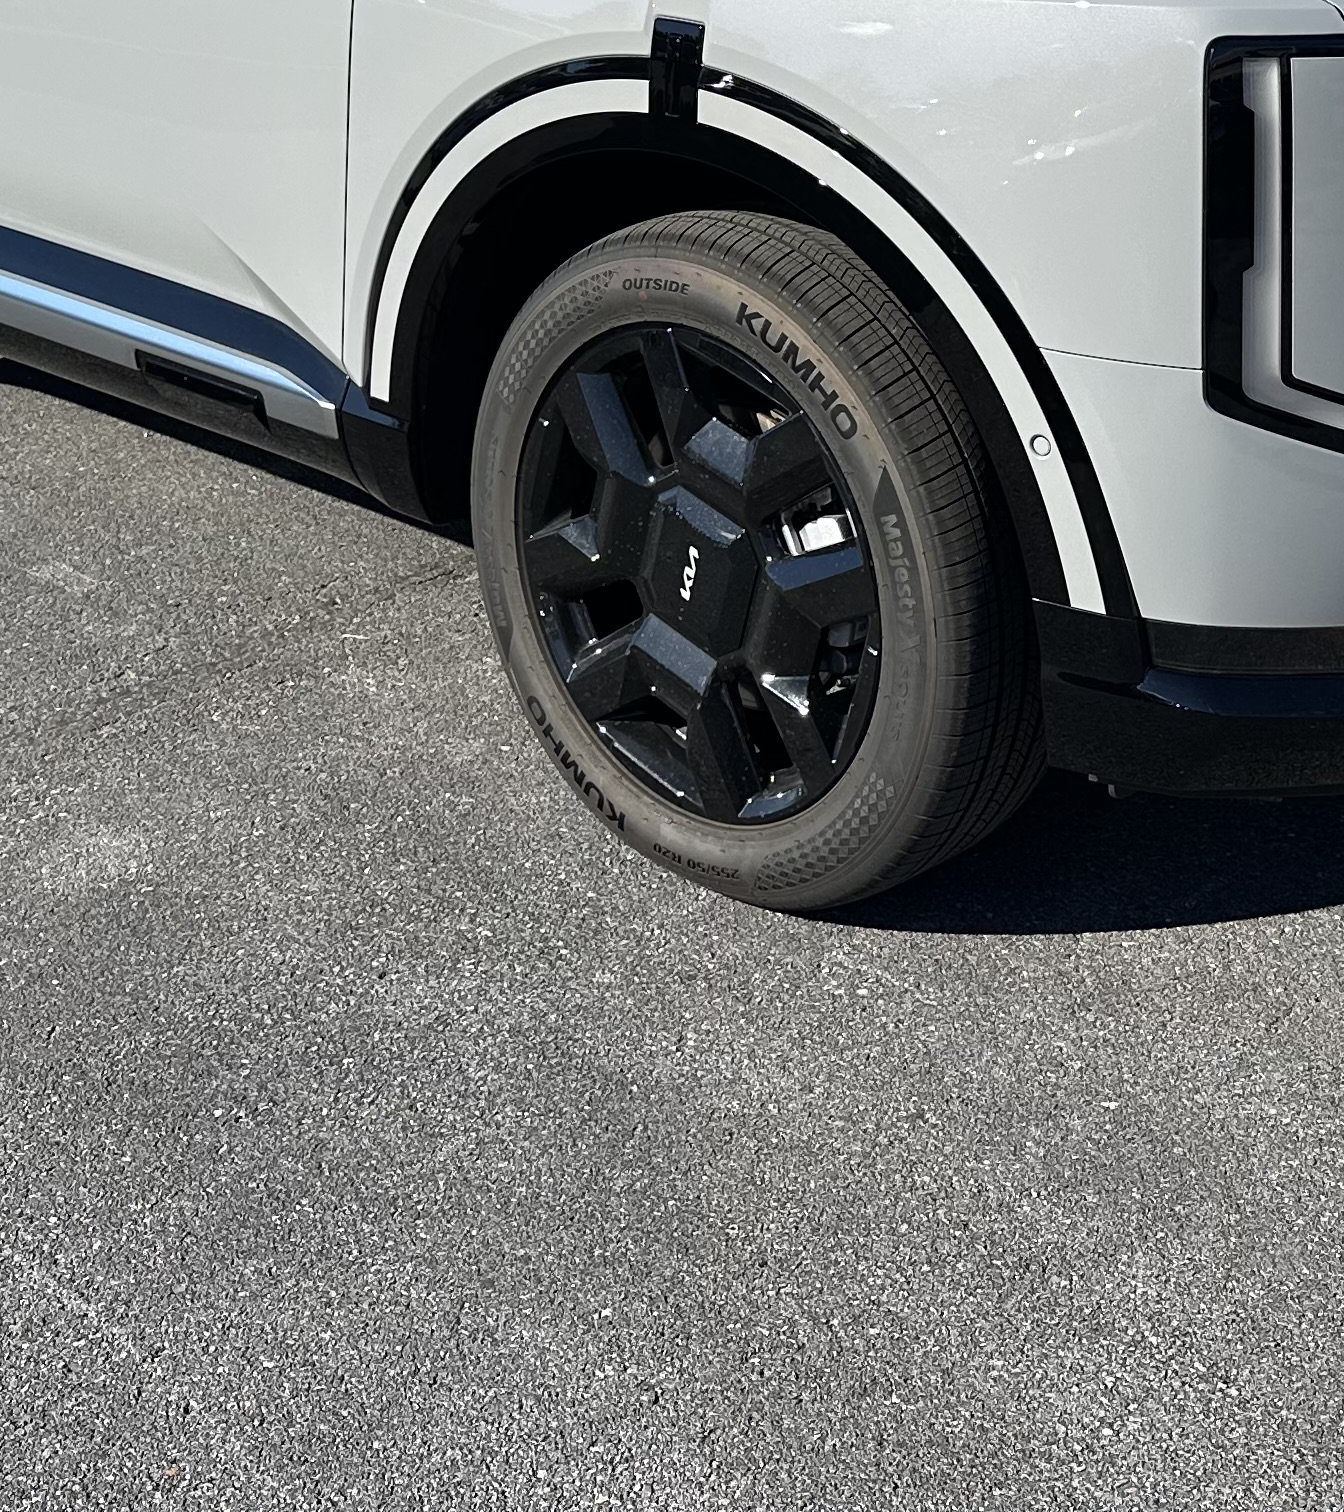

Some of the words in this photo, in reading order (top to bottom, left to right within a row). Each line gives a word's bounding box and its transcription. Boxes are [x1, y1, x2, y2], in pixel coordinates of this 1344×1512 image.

[622, 277, 691, 296] OUTSIDE
[735, 301, 858, 440] KUMHO
[680, 545, 700, 601] KIA
[879, 513, 917, 626] Majesty
[527, 695, 627, 831] KUMHO
[653, 842, 682, 865] R20
[686, 858, 740, 880] 255/50
